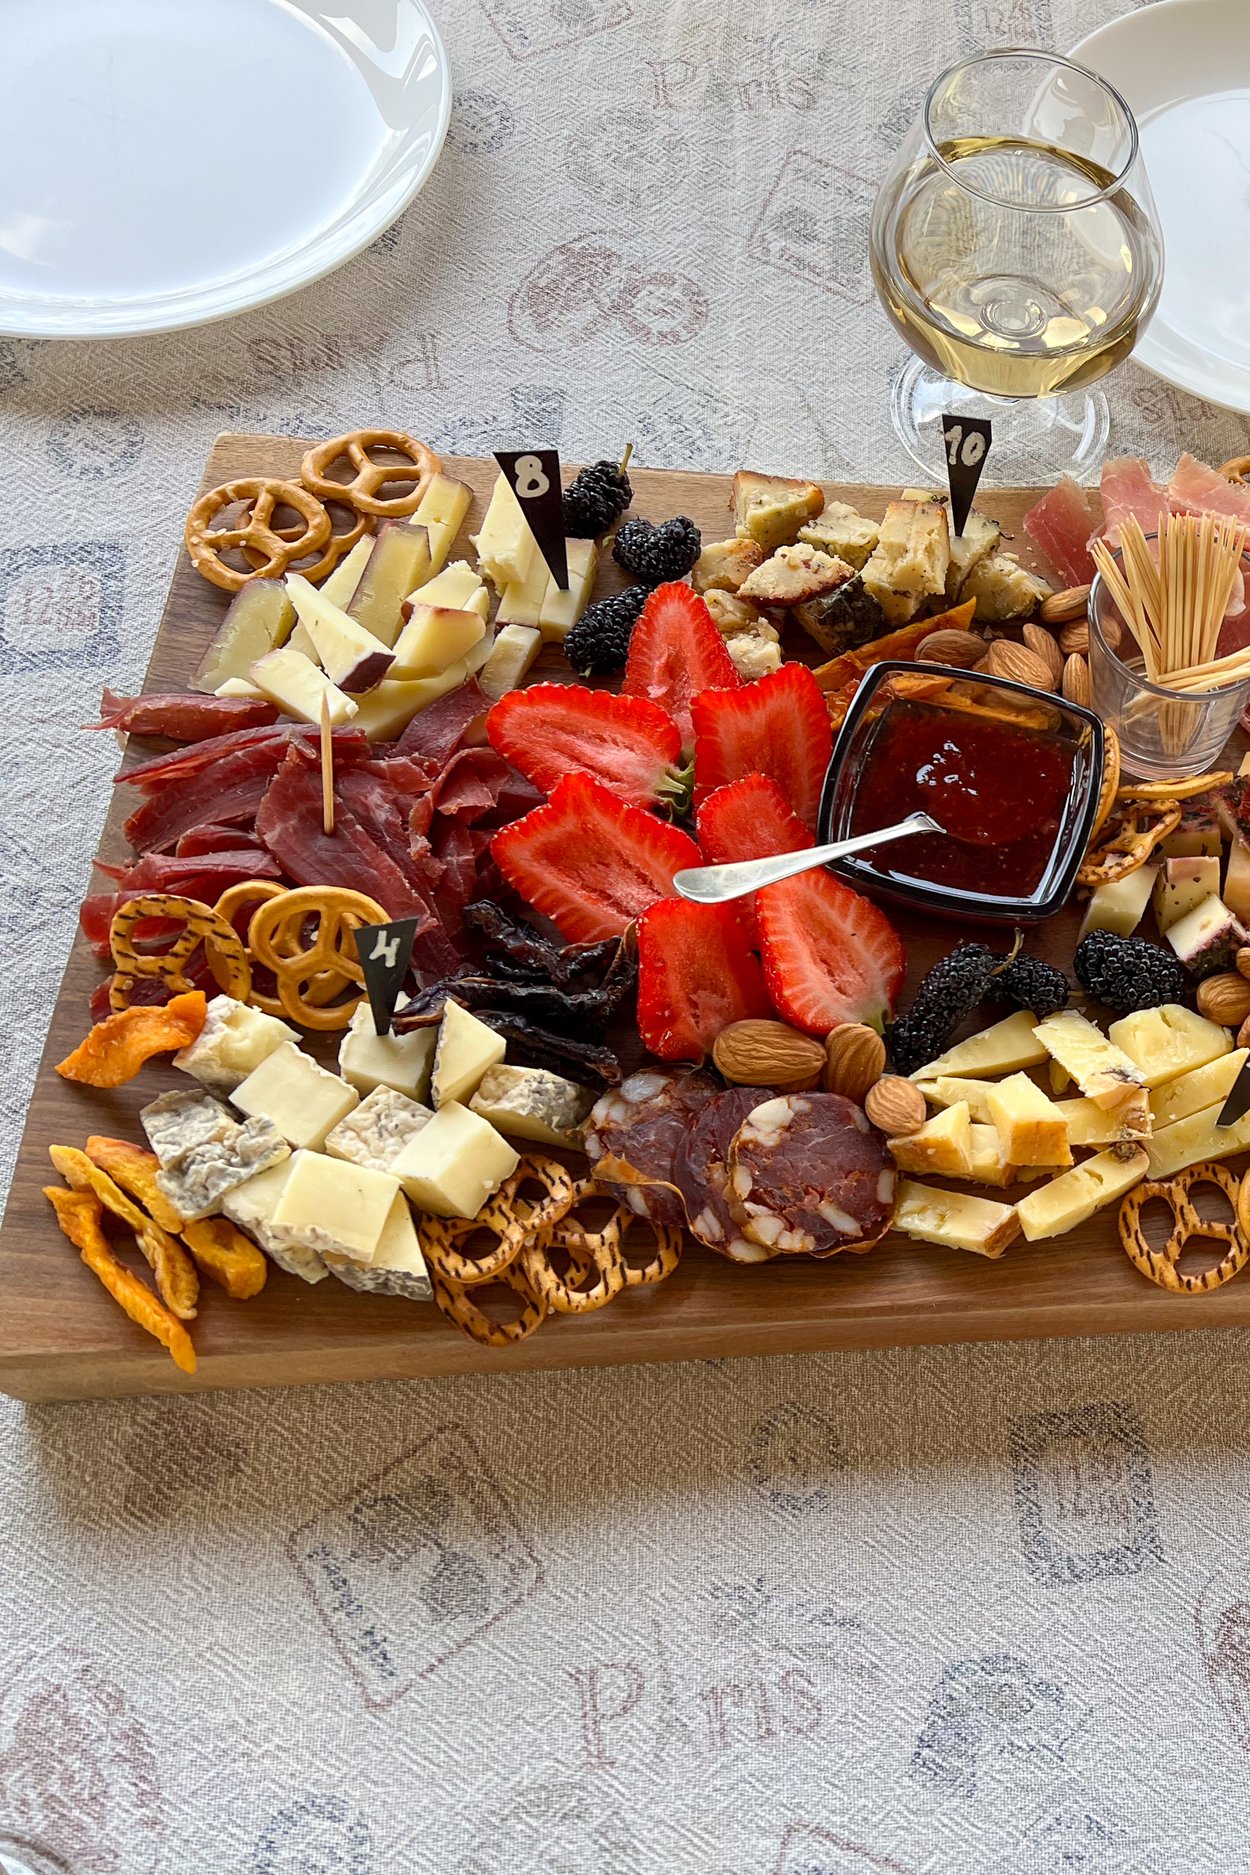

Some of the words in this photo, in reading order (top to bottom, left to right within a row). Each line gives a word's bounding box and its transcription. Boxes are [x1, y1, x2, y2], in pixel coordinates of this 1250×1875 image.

[946, 425, 986, 466] 10
[515, 455, 550, 499] 8
[367, 929, 400, 968] 4
[568, 1652, 822, 1770] Pris
